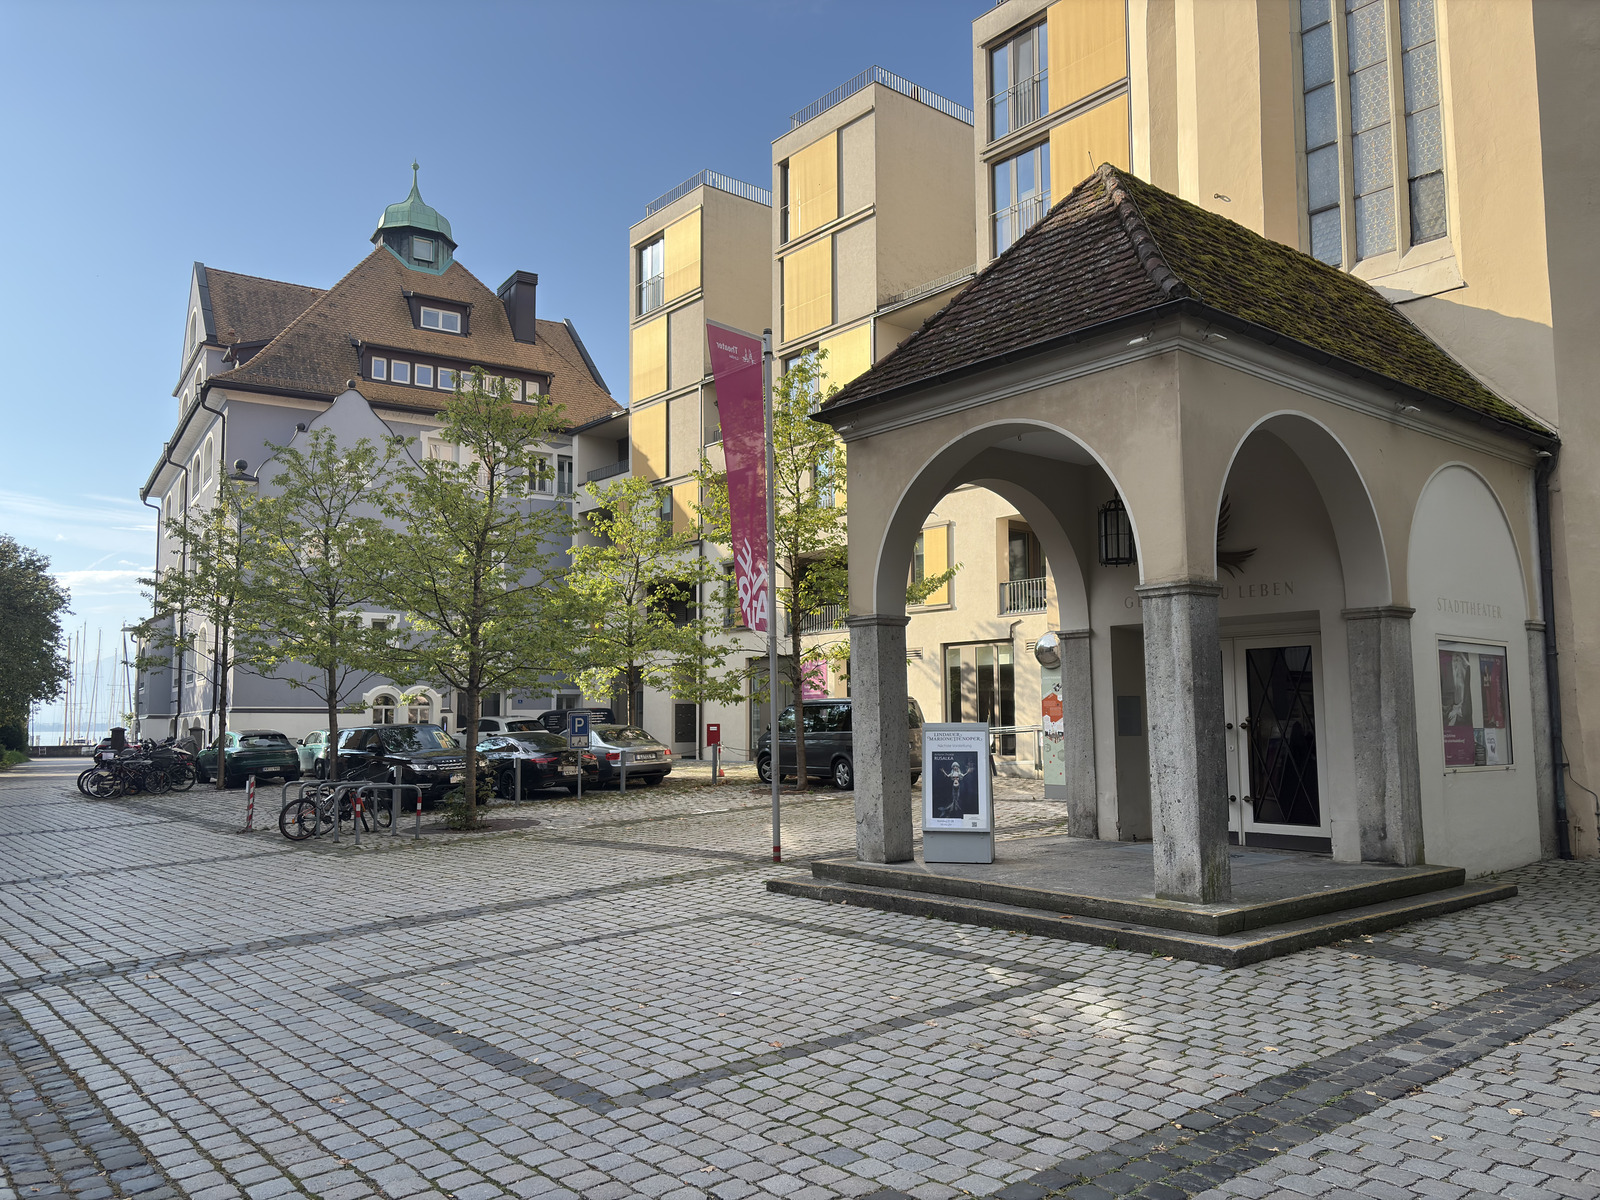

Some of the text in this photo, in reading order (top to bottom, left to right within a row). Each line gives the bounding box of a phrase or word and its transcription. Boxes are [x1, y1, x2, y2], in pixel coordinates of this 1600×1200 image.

[1239, 581, 1294, 599] LEBEN
[1437, 597, 1504, 619] STADTTHEATER
[575, 718, 584, 733] P
